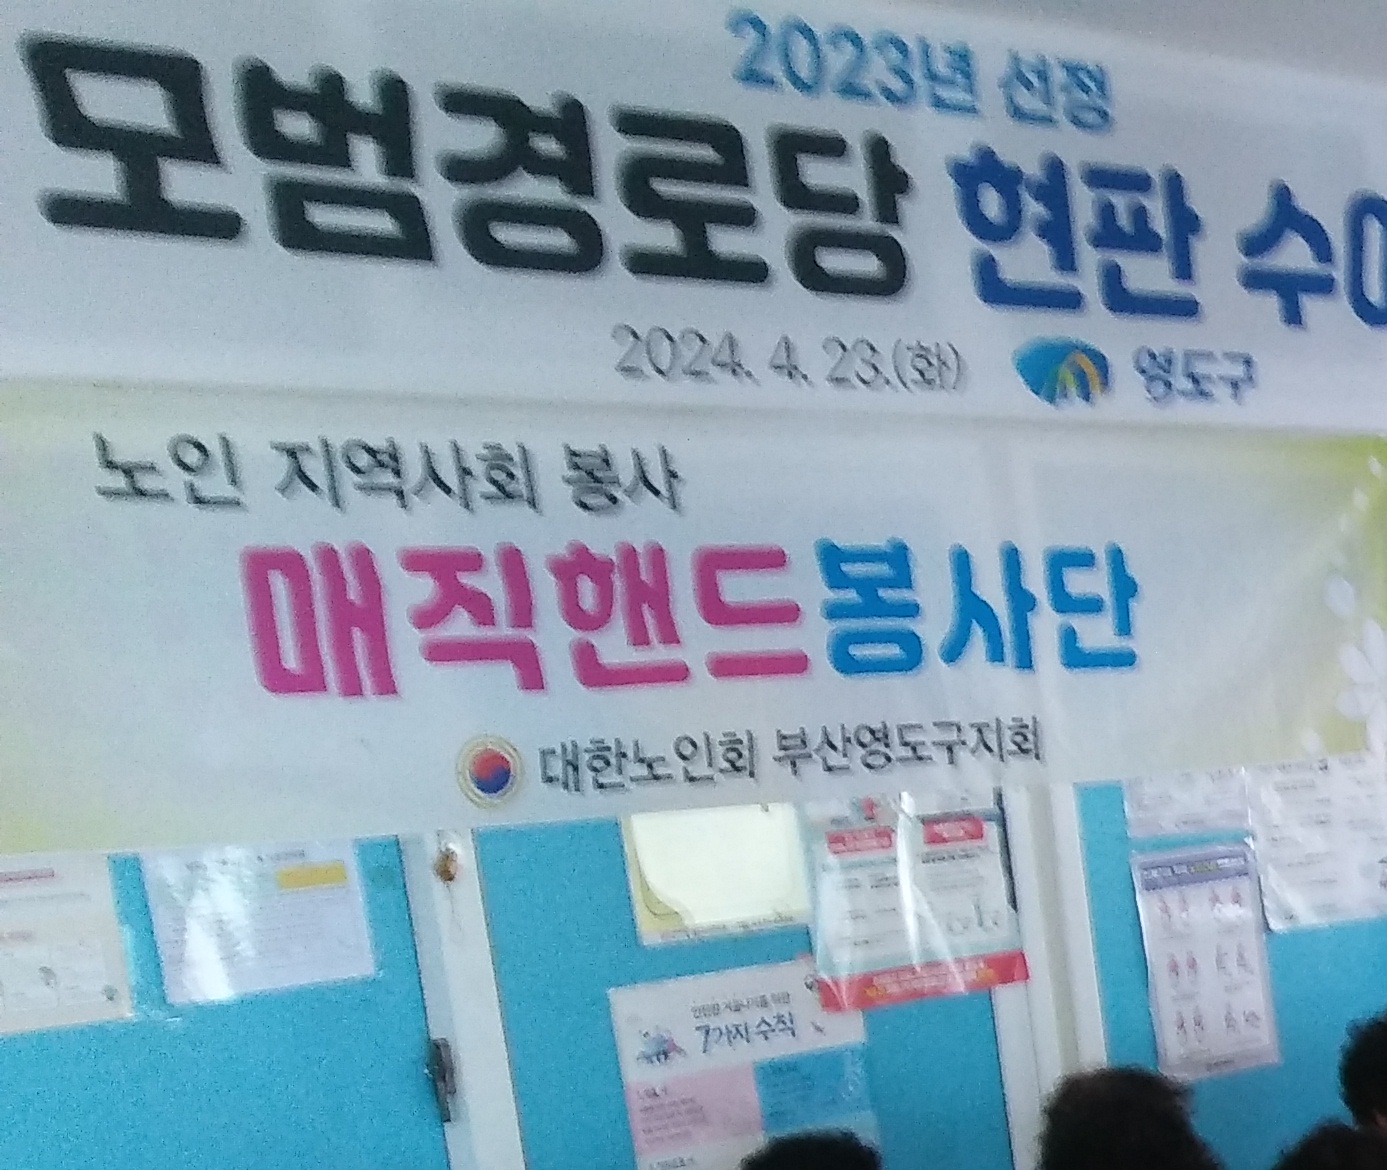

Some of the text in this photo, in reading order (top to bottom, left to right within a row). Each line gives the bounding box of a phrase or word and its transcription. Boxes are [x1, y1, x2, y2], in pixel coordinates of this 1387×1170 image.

[726, 8, 1116, 132] 2023년 선정
[18, 30, 913, 298] 모범경로당
[946, 143, 1201, 323] 현판
[611, 323, 754, 387] 2024.
[770, 332, 809, 390] 4.
[1133, 346, 1258, 405] 영도구
[93, 430, 684, 515] 노인 지역사회 봉사
[241, 540, 1139, 697] 매직핸드봉사단
[538, 716, 1043, 789] 대한노인회 부산영도구지회
[695, 1011, 796, 1053] 7가지 수칙
